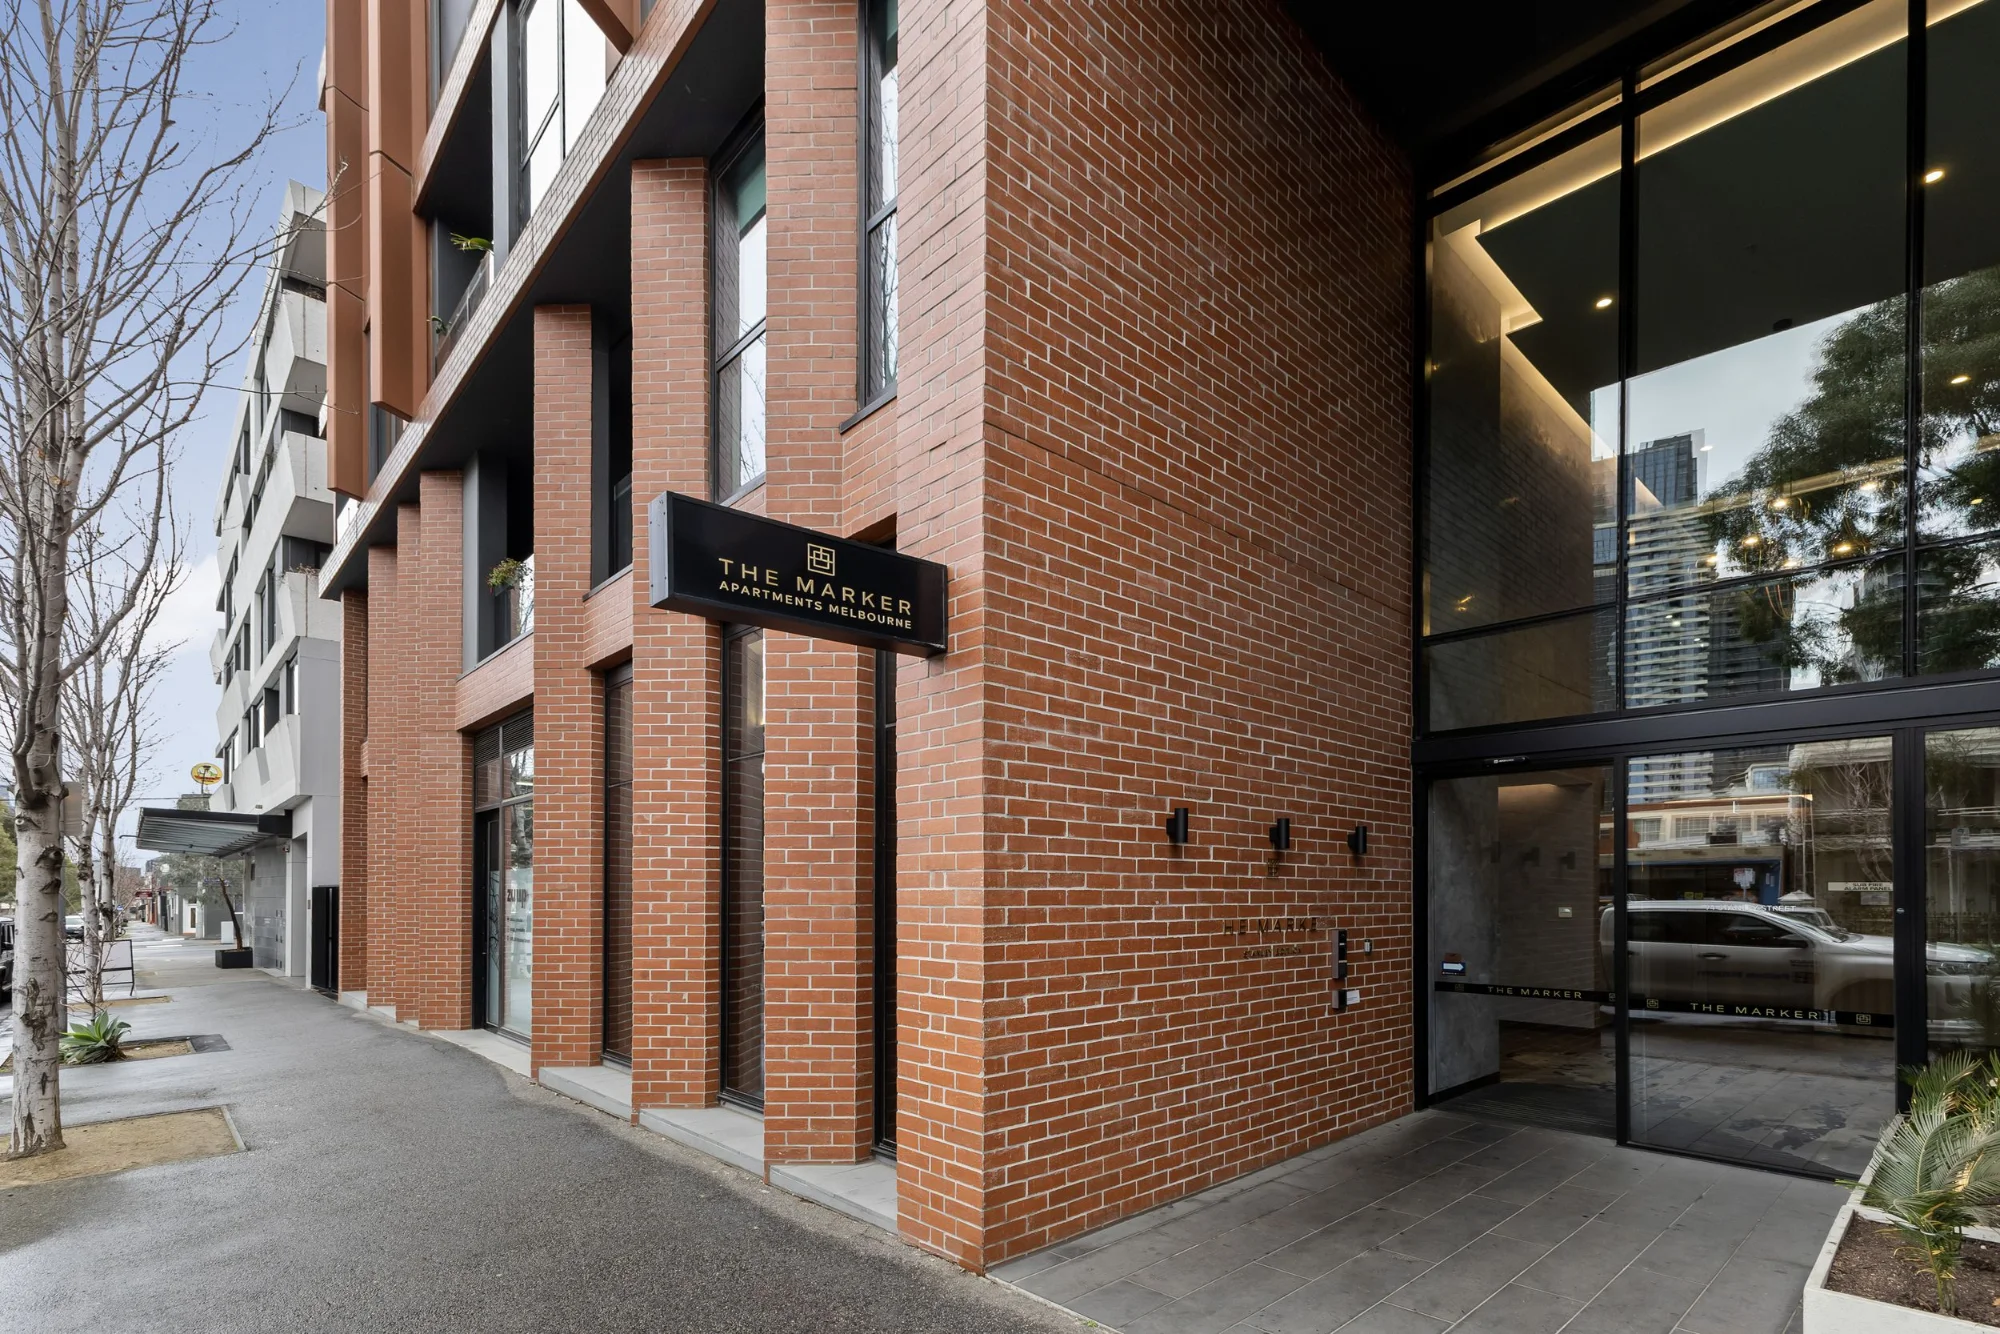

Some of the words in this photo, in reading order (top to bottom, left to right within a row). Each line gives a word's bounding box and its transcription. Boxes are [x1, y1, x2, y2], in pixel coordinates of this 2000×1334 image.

[718, 557, 779, 587] THE
[796, 576, 912, 616] MARKER
[719, 580, 823, 611] APARTMENTS
[829, 605, 912, 630] MELBOURNE
[1487, 986, 1513, 995] THE
[1520, 988, 1583, 999] MARKER
[1690, 1003, 1725, 1013] THE
[1735, 1006, 1818, 1020] MARKER
